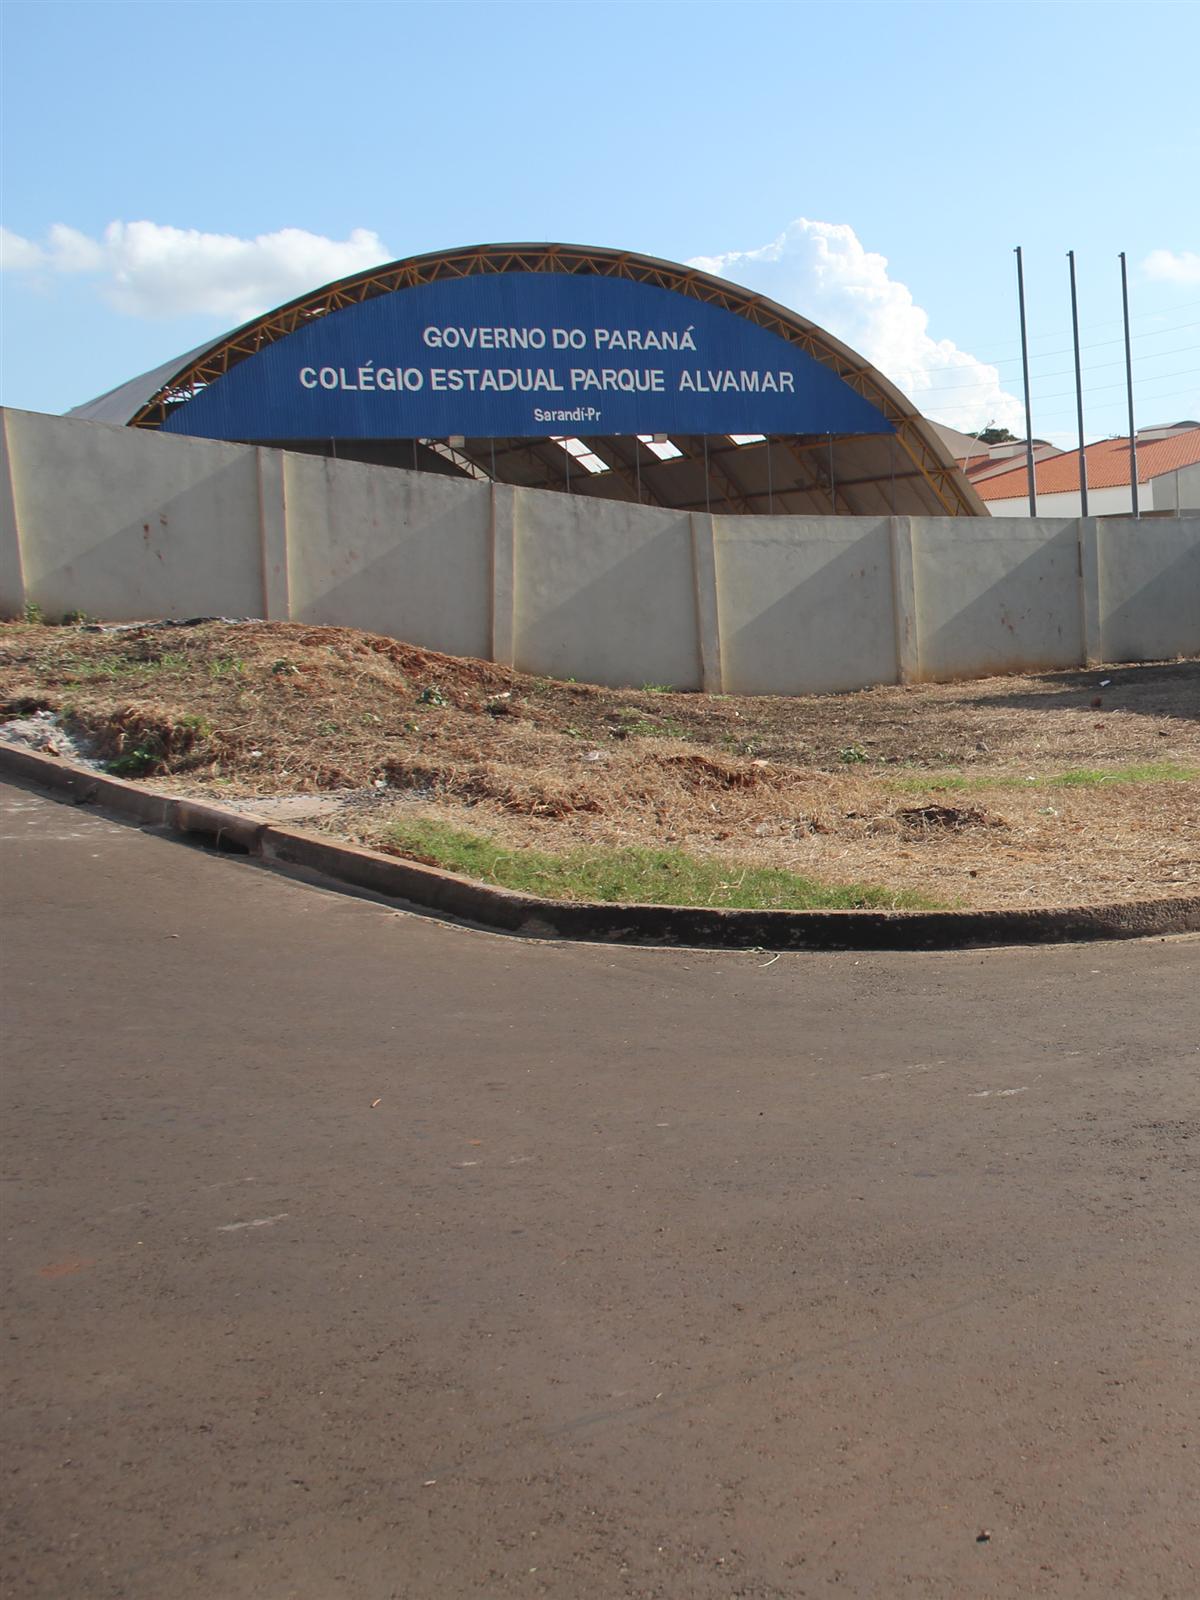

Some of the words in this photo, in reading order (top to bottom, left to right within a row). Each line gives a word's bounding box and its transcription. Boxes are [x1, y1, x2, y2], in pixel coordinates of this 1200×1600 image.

[422, 326, 546, 349] GOVERNO
[551, 328, 587, 349] DO
[594, 325, 697, 351] PARANÁ
[299, 360, 424, 392] COLÉGIO
[430, 368, 564, 391] ESTADUAL
[570, 368, 665, 393] PARQUE
[678, 370, 795, 393] ALVAMAR
